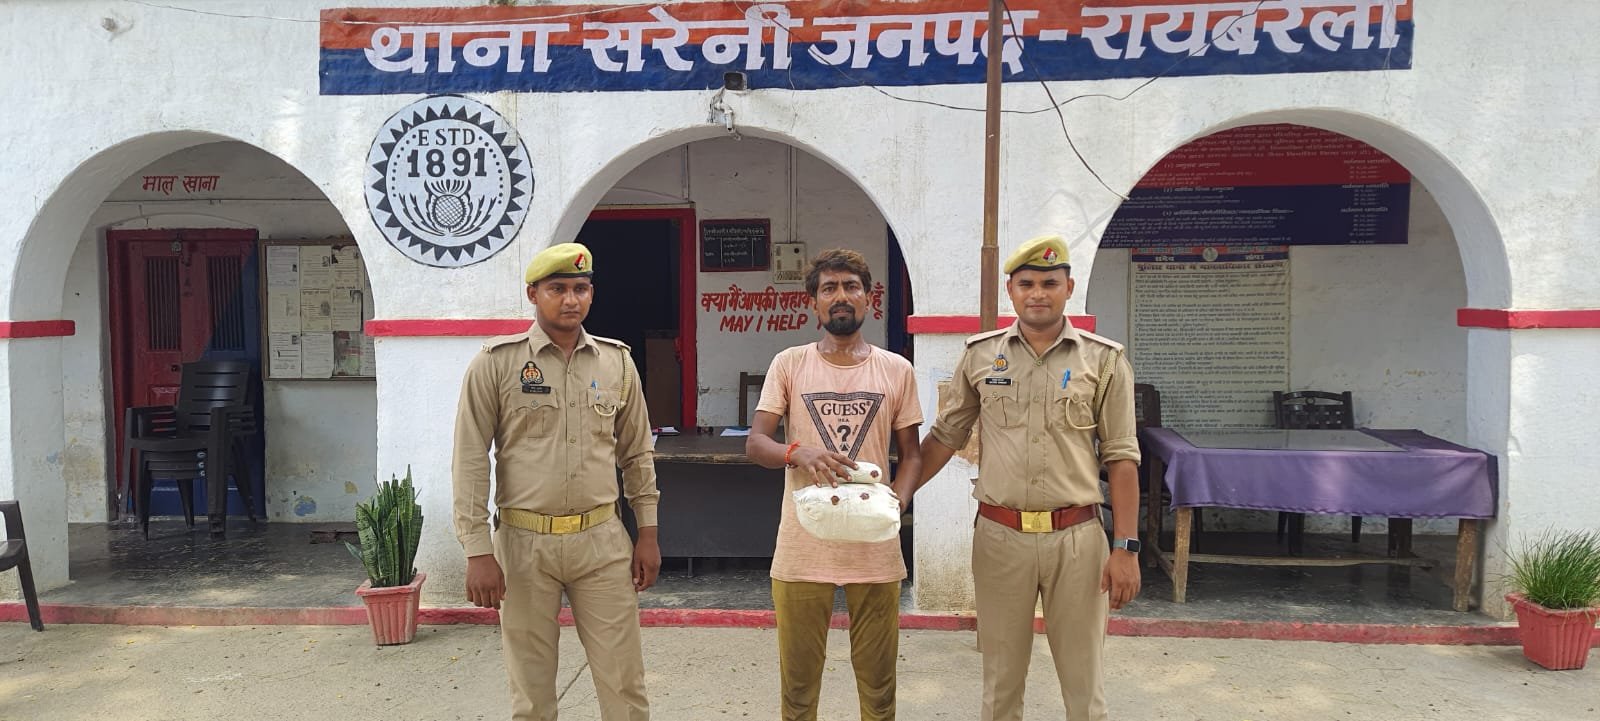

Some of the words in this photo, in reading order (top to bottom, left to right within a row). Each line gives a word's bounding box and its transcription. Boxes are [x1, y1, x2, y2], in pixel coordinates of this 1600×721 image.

[363, 23, 569, 73] थाना
[583, 3, 803, 72] सरेनी
[808, 10, 1039, 75] जनपद
[407, 147, 488, 178] 1891
[142, 175, 179, 196] माल
[182, 175, 221, 194] खाना
[701, 292, 728, 313] क्या
[728, 284, 742, 312] मैं
[739, 286, 778, 312] आपकी
[720, 315, 754, 333] MAY
[756, 315, 764, 333] I
[767, 313, 808, 332] HELP
